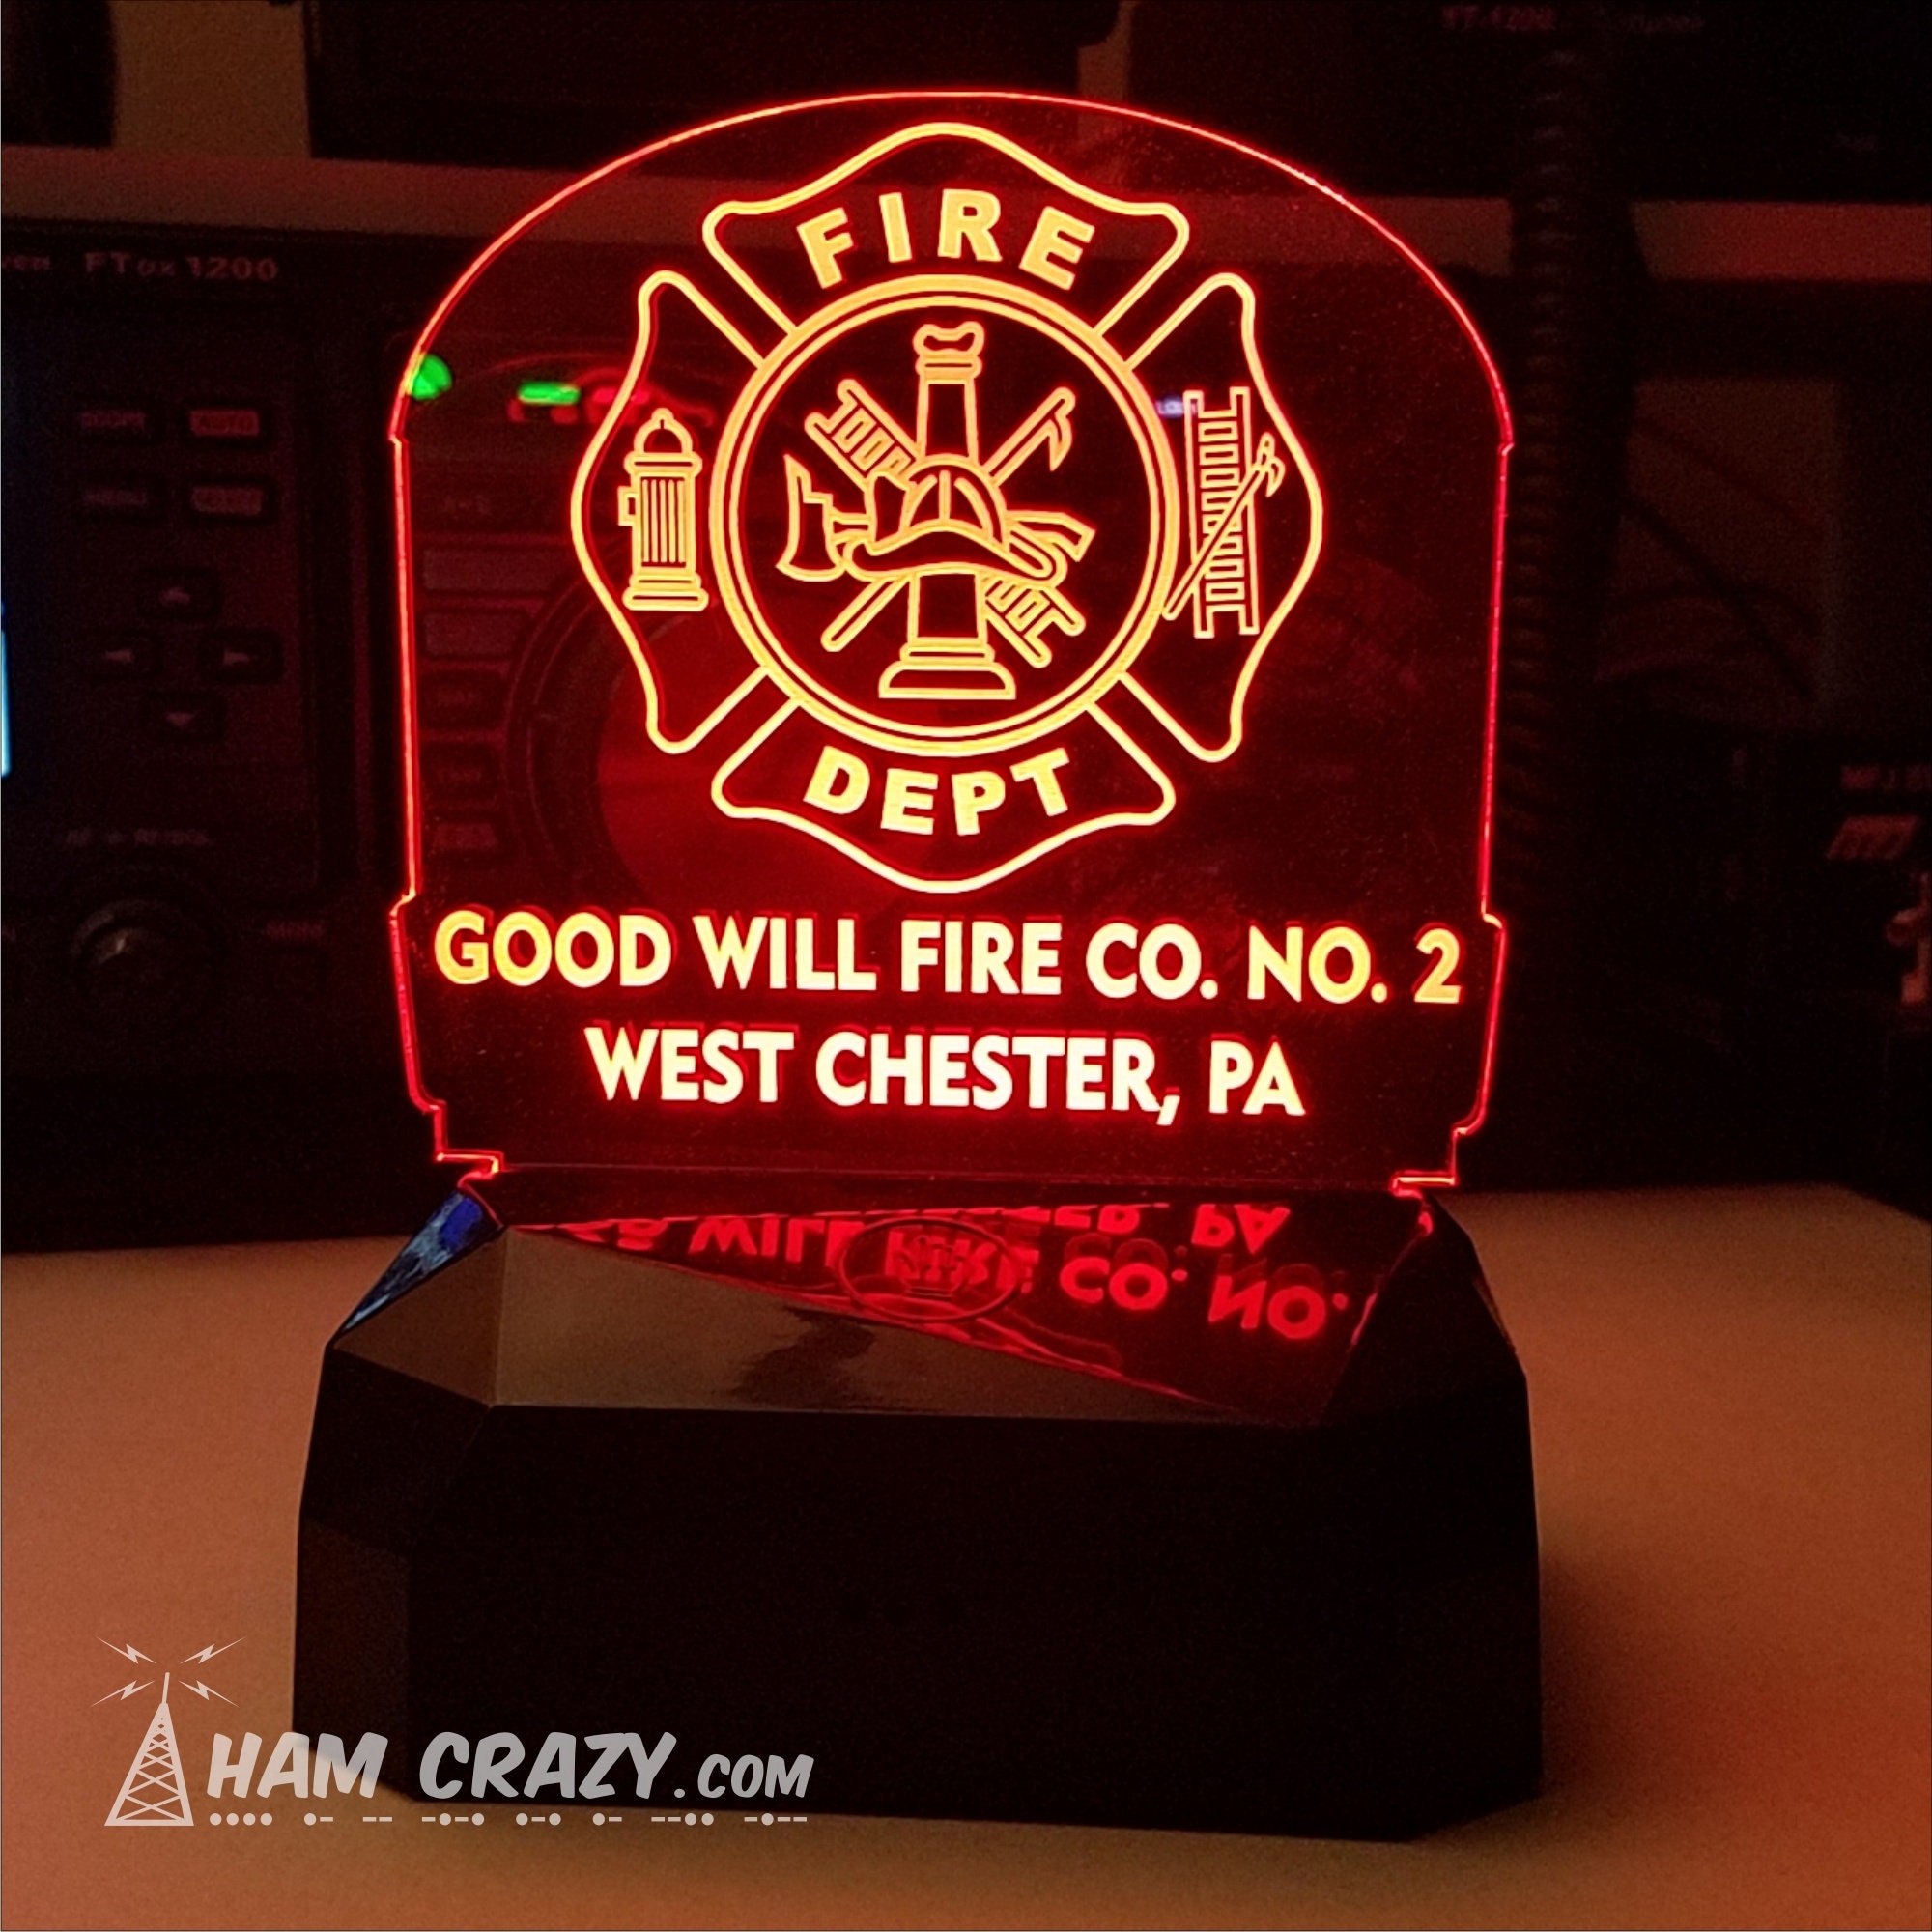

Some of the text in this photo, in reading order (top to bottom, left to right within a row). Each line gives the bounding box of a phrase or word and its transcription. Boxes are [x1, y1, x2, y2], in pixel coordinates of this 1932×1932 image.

[185, 255, 280, 282] 1200
[797, 188, 1095, 290] FIRE
[804, 745, 1070, 837] DEPT
[435, 911, 1460, 1004] GOOD WILL FIRE CO. NO. 2
[584, 1028, 1305, 1125] WEST CHESTER, PA
